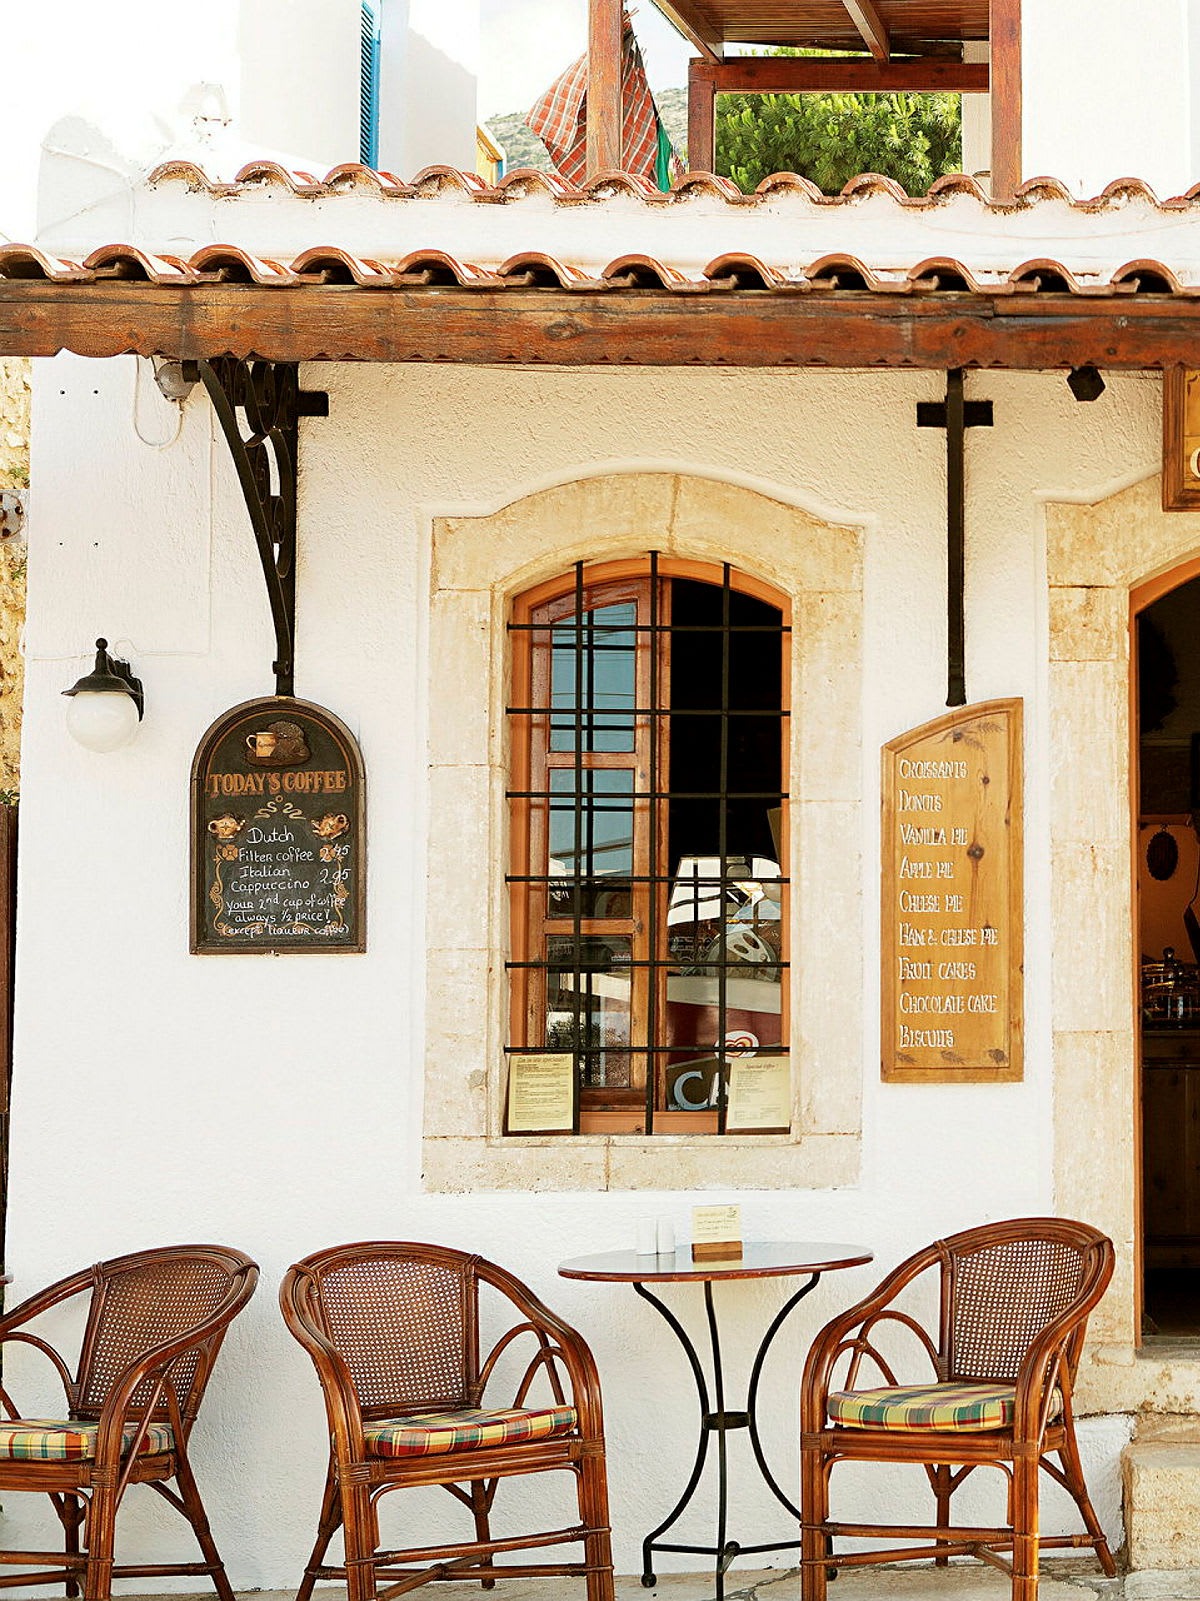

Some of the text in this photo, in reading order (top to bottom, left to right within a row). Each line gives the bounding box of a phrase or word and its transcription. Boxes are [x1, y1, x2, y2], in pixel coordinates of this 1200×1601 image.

[899, 759, 968, 779] CROISSANTS
[207, 770, 345, 795] TODAY'S COFFEE
[899, 789, 942, 812] DONUTS
[246, 825, 295, 844] Dutch
[900, 823, 968, 846] VANILLA PIE
[276, 846, 314, 862] coffee
[240, 865, 290, 879] Italian
[899, 856, 954, 879] APPLE PIE
[231, 879, 310, 895] Cappuccino
[283, 898, 303, 910] cup
[305, 892, 315, 908] of
[317, 893, 346, 908] coffee
[900, 890, 964, 913] CHEESE PIE
[235, 910, 276, 928] always
[899, 922, 926, 946] HAM
[941, 928, 977, 945] CHEESE
[980, 928, 999, 945] PIE
[899, 957, 977, 980] FRUIT CAKES
[900, 992, 999, 1014] CHOCOLATE CAKE
[900, 1025, 954, 1048] BISCUITS
